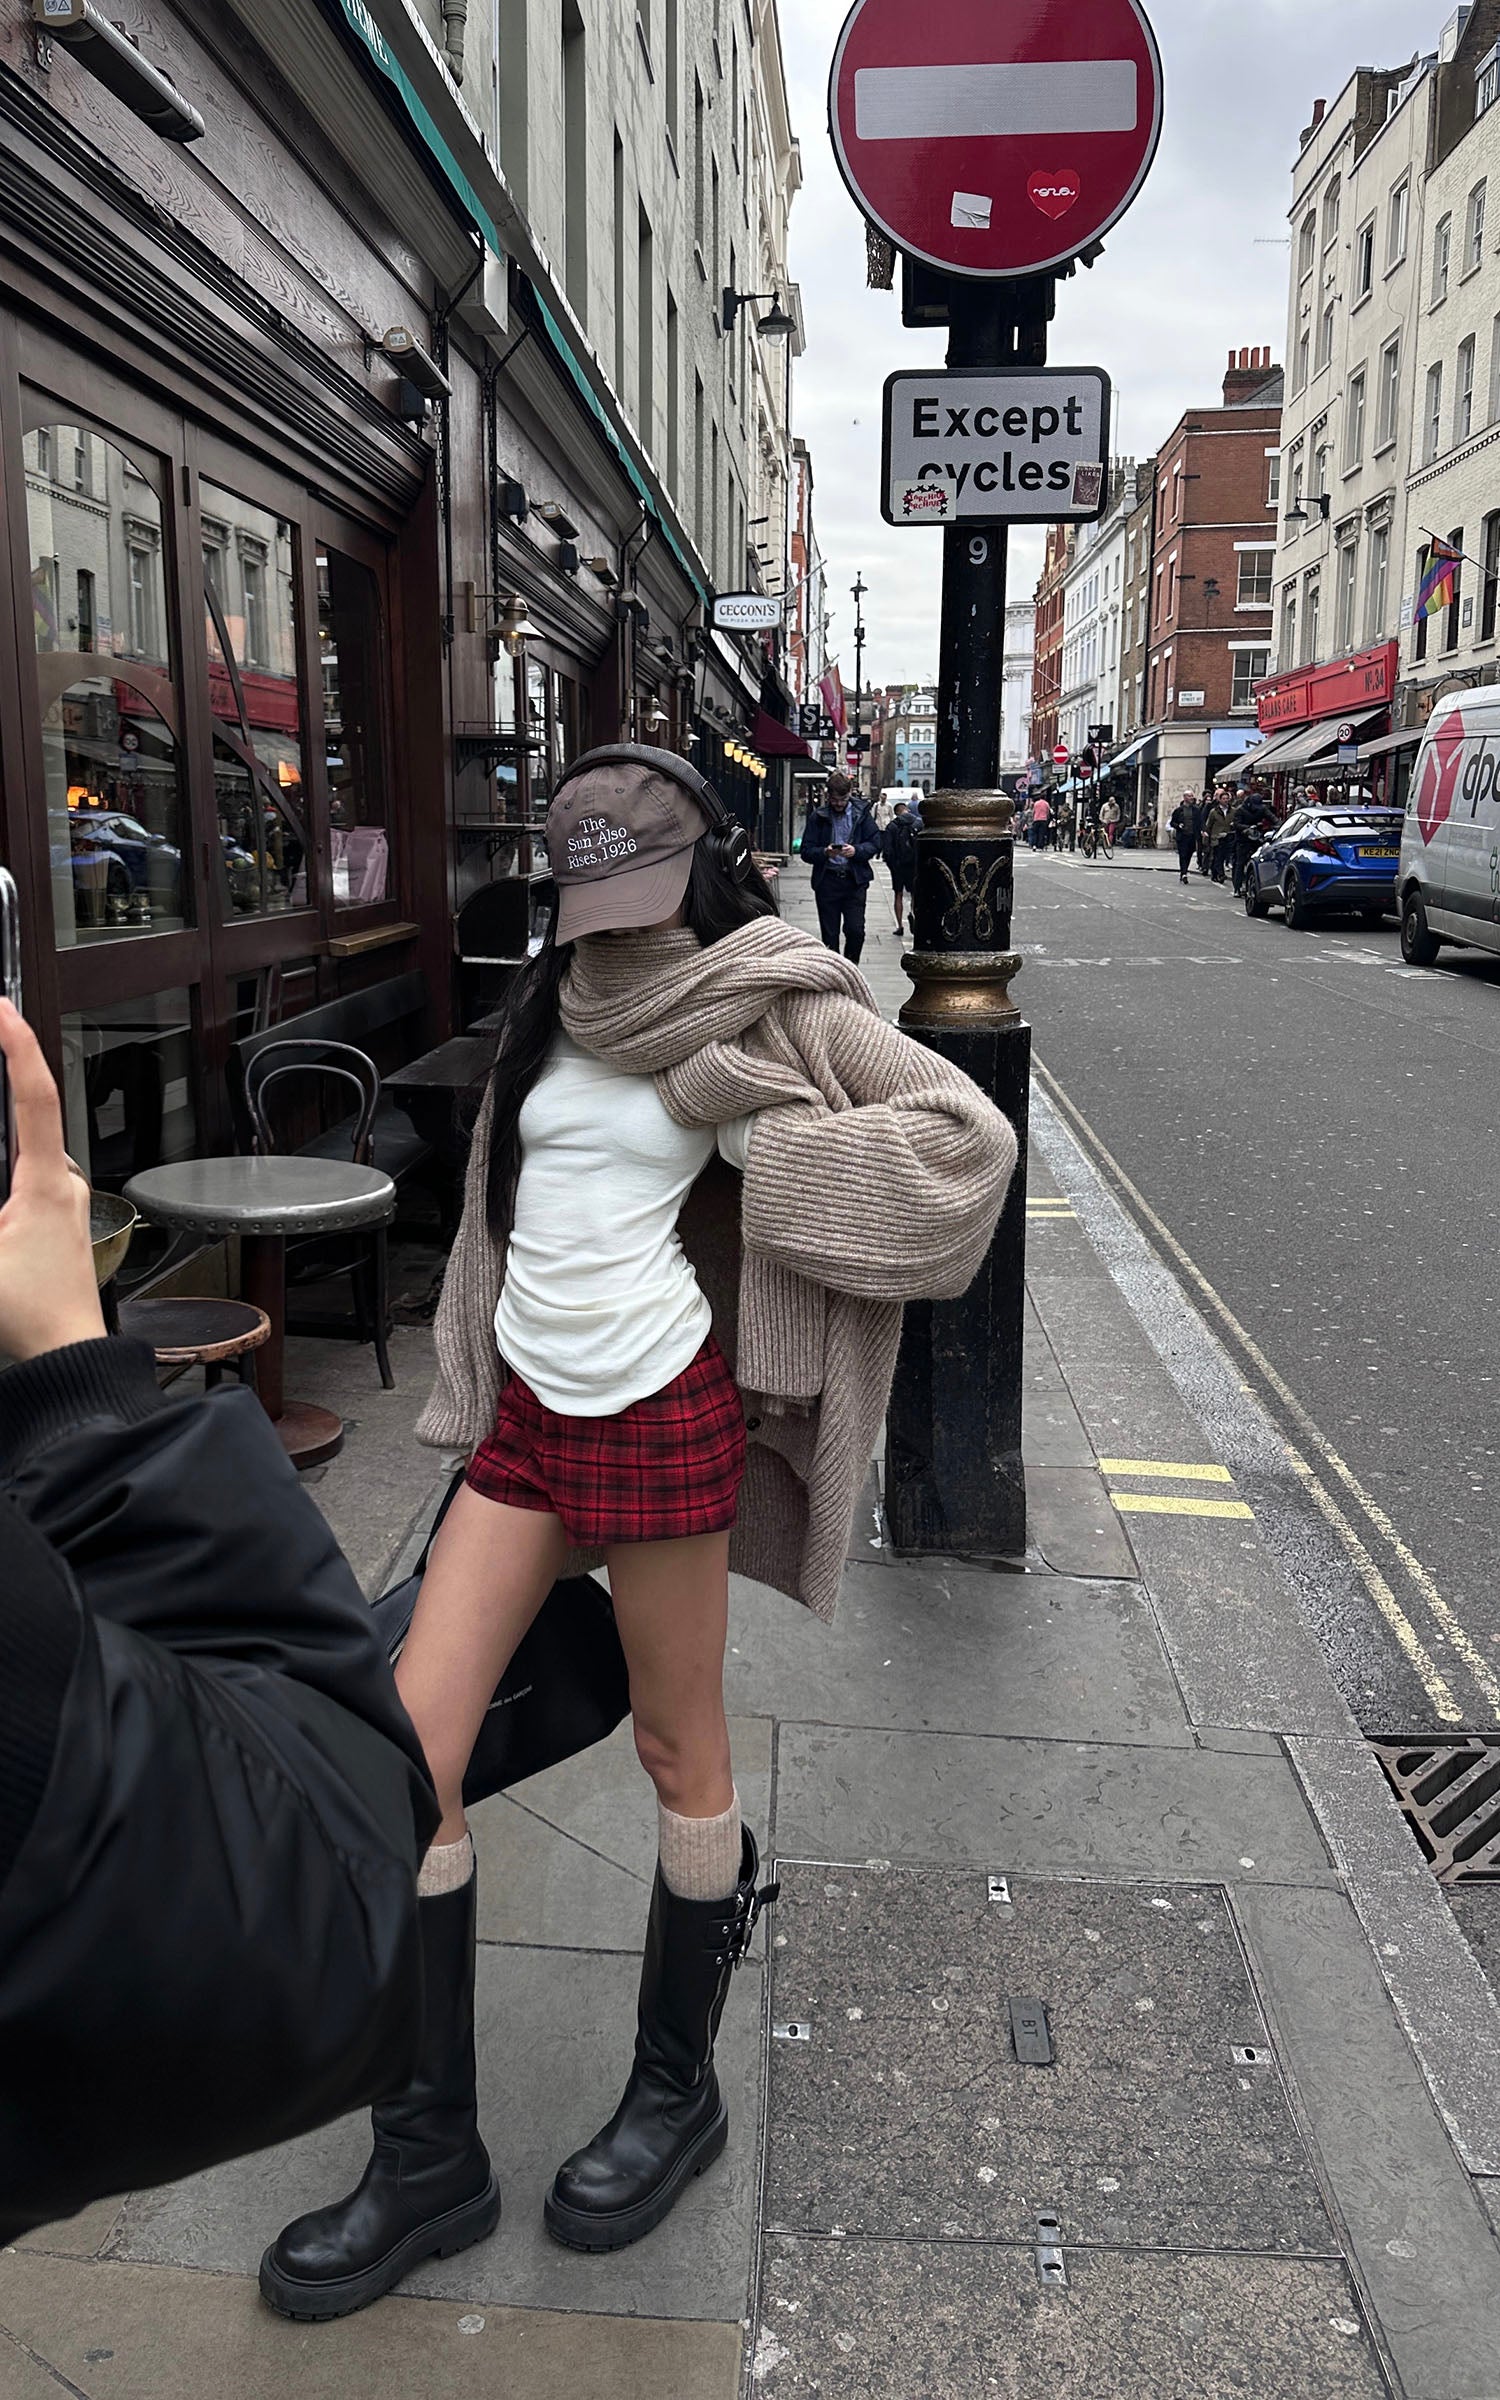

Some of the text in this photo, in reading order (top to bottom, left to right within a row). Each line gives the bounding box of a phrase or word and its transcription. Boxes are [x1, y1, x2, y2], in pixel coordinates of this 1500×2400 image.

[913, 395, 1082, 443] Except
[917, 452, 1070, 499] cycles
[969, 537, 988, 565] 9
[720, 604, 775, 616] CECCONI'S
[1340, 728, 1349, 737] 20
[579, 818, 606, 833] The
[568, 827, 627, 851] Sun Also
[1022, 2020, 1038, 2037] BT
